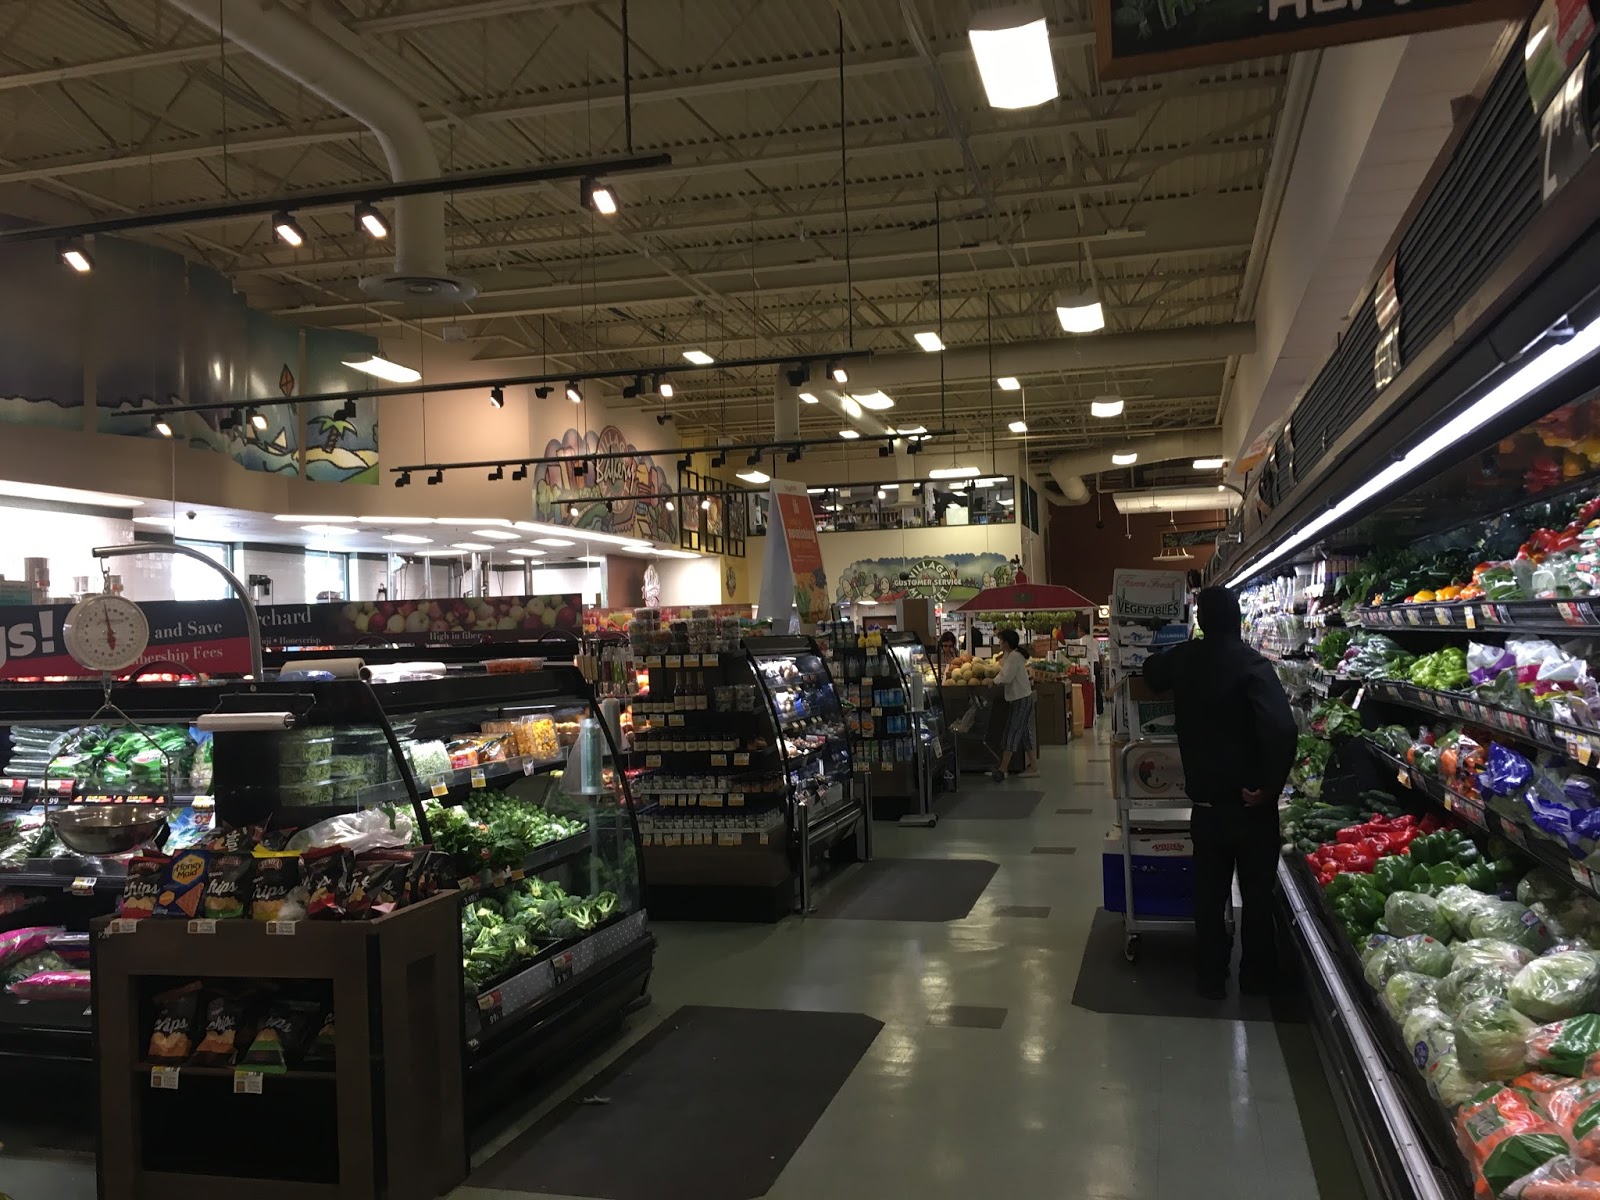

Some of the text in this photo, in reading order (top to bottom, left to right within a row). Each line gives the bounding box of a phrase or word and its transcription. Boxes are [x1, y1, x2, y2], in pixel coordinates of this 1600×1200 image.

[909, 561, 949, 579] VILLAGE
[1117, 599, 1179, 616] VEGETABLES
[155, 620, 223, 639] and Save
[430, 631, 450, 642] High
[452, 631, 460, 640] in
[193, 645, 224, 659] Fees
[175, 860, 203, 873] Honey
[176, 869, 198, 879] Maid
